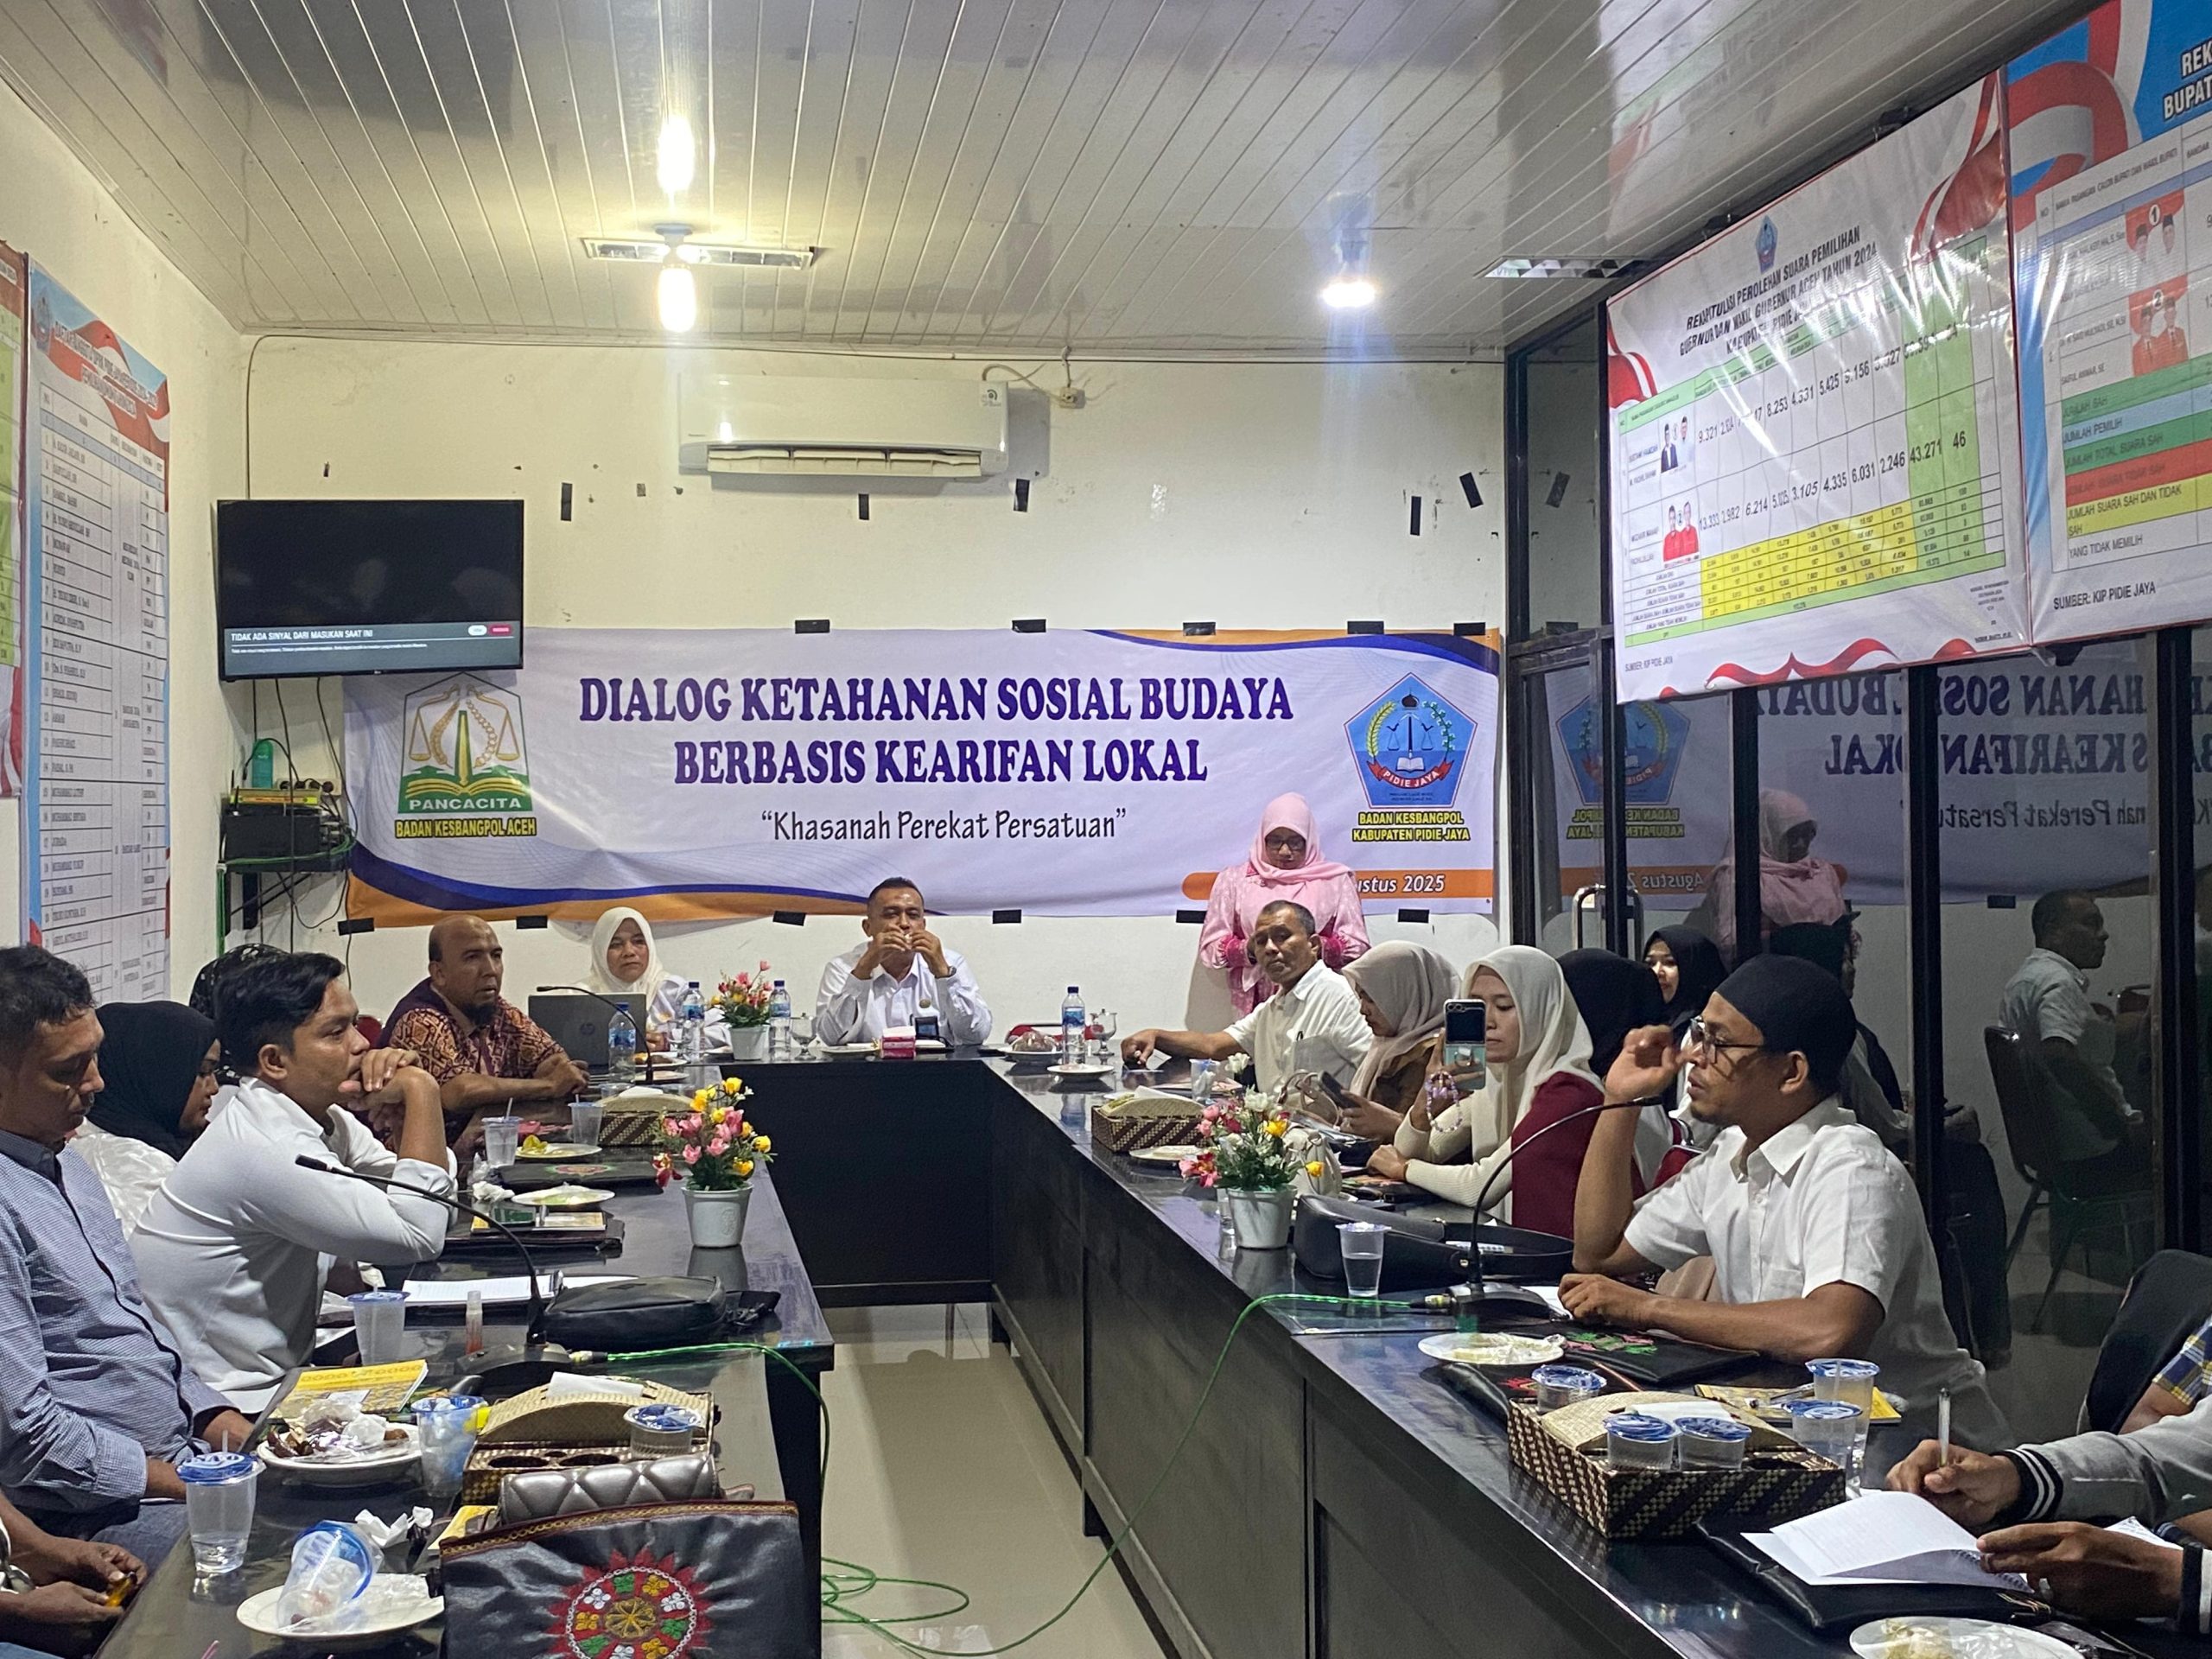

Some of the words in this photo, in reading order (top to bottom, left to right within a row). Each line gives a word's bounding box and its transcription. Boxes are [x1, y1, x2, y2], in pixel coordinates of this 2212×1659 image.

[2151, 207, 2158, 223] 1
[1737, 272, 1782, 303] PEROLEHAN
[1783, 254, 1810, 281] SUARA
[1811, 226, 1860, 265] PEMILIHAN
[1755, 284, 1796, 318] GUBERNUR
[1821, 256, 1852, 282] TAHUN
[1853, 241, 1878, 267] 2024
[2154, 291, 2162, 307] 2
[1767, 396, 1789, 417] 8.253
[1791, 385, 1814, 405] 4.331
[1819, 373, 1839, 396] 5.425
[2063, 427, 2093, 442] JUMLAH
[2094, 418, 2123, 435] PEMILIH
[2120, 439, 2145, 454] SUARA
[2147, 434, 2164, 447] SAH
[1745, 499, 1769, 516] 6.214
[1792, 481, 1818, 501] 3.105
[1823, 472, 1847, 493] 4.335
[1852, 462, 1876, 484] 6.031
[1880, 451, 1905, 475] 2.246
[1910, 439, 1942, 464] 43.271
[1953, 430, 1967, 450] 46
[2068, 505, 2094, 520] JUMLAH
[2097, 501, 2122, 514] SUARA
[2123, 496, 2139, 508] SAH
[2140, 492, 2157, 504] DAN
[2159, 486, 2183, 500] TIDAK
[2069, 524, 2083, 537] SAH
[2069, 546, 2088, 559] YANG
[2089, 543, 2111, 555] TIDAK
[2113, 535, 2143, 550] MEMILIH
[2053, 594, 2092, 612] SUMBER:
[2093, 588, 2107, 604] KIP
[2108, 585, 2132, 601] PIDIE
[2133, 581, 2157, 597] JAYA
[231, 632, 251, 641] TIDAK
[252, 632, 267, 640] ADA
[268, 631, 292, 640] SINYAL
[293, 631, 309, 639] DARI
[310, 630, 344, 639] MASUKAN
[345, 630, 362, 639] SAAT
[363, 629, 373, 638] INI
[579, 677, 731, 722] DIALOG
[741, 677, 988, 721] KETAHANAN
[997, 677, 1130, 721] SOSIAL
[1141, 677, 1294, 721] BUDAYA
[675, 741, 866, 785] BERBASIS
[874, 740, 1072, 784] KEARIFAN
[1083, 739, 1207, 782] LOKAL
[1382, 770, 1411, 787] PIDIE
[1414, 770, 1440, 787] JAYA
[410, 798, 522, 810] PANCACITA
[396, 820, 431, 838] BADAN
[434, 819, 505, 837] KESBANGPOL
[506, 818, 537, 836] ACEH
[897, 810, 988, 842] Perekat
[1358, 812, 1393, 824] BADAN
[1395, 811, 1464, 824] KESBANGPOL
[1353, 829, 1413, 841] KABUPATEN
[1415, 828, 1443, 841] PIDIE
[1445, 828, 1470, 840] JAYA
[1402, 874, 1446, 893] 2025
